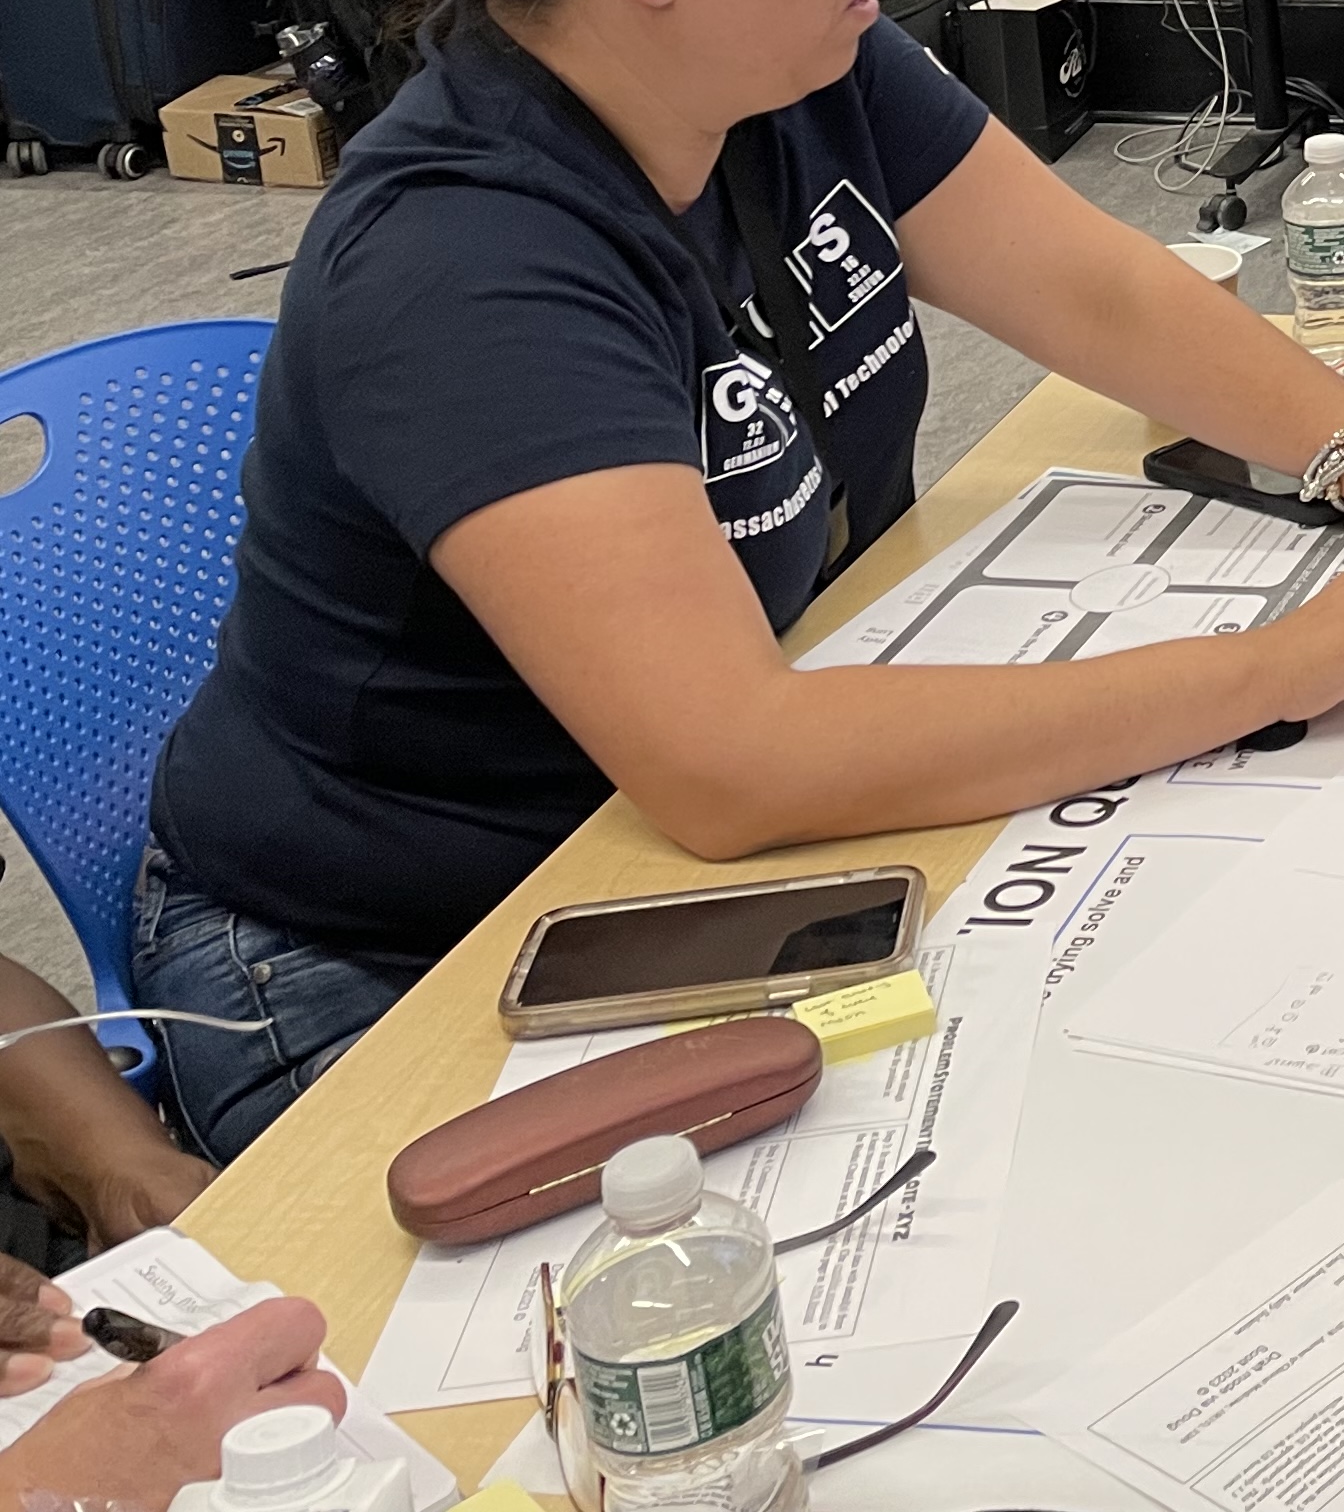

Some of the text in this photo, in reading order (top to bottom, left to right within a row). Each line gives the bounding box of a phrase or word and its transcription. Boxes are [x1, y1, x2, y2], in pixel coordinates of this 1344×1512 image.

[809, 213, 851, 263] S
[1044, 855, 1146, 986] trying solve and
[1166, 1407, 1203, 1432] Doug
